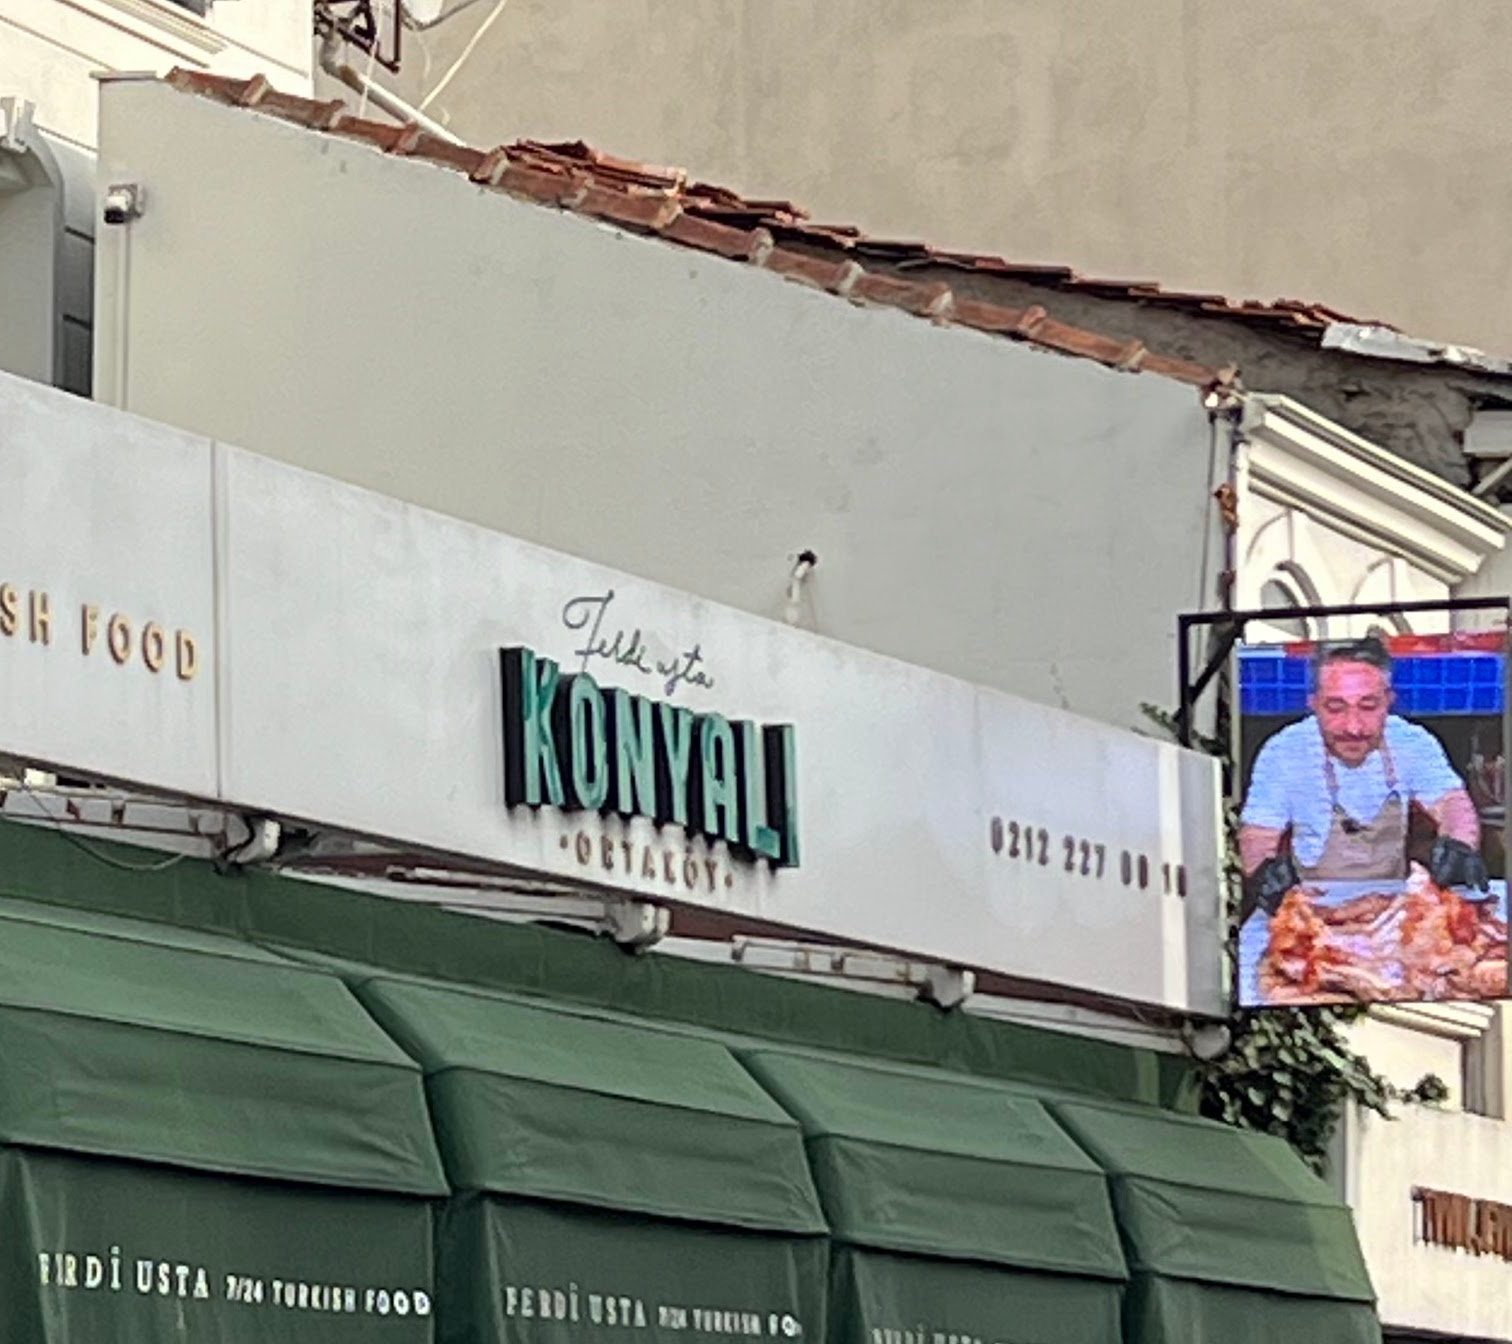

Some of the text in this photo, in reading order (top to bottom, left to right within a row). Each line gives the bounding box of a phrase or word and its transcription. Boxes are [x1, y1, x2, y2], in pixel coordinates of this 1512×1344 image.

[81, 602, 199, 681] FOOD
[499, 645, 801, 868] KONYALI
[136, 1260, 210, 1299] USTA
[272, 1279, 356, 1313] TURKISH
[364, 1288, 432, 1316] FOOD
[588, 1293, 647, 1328] USTA
